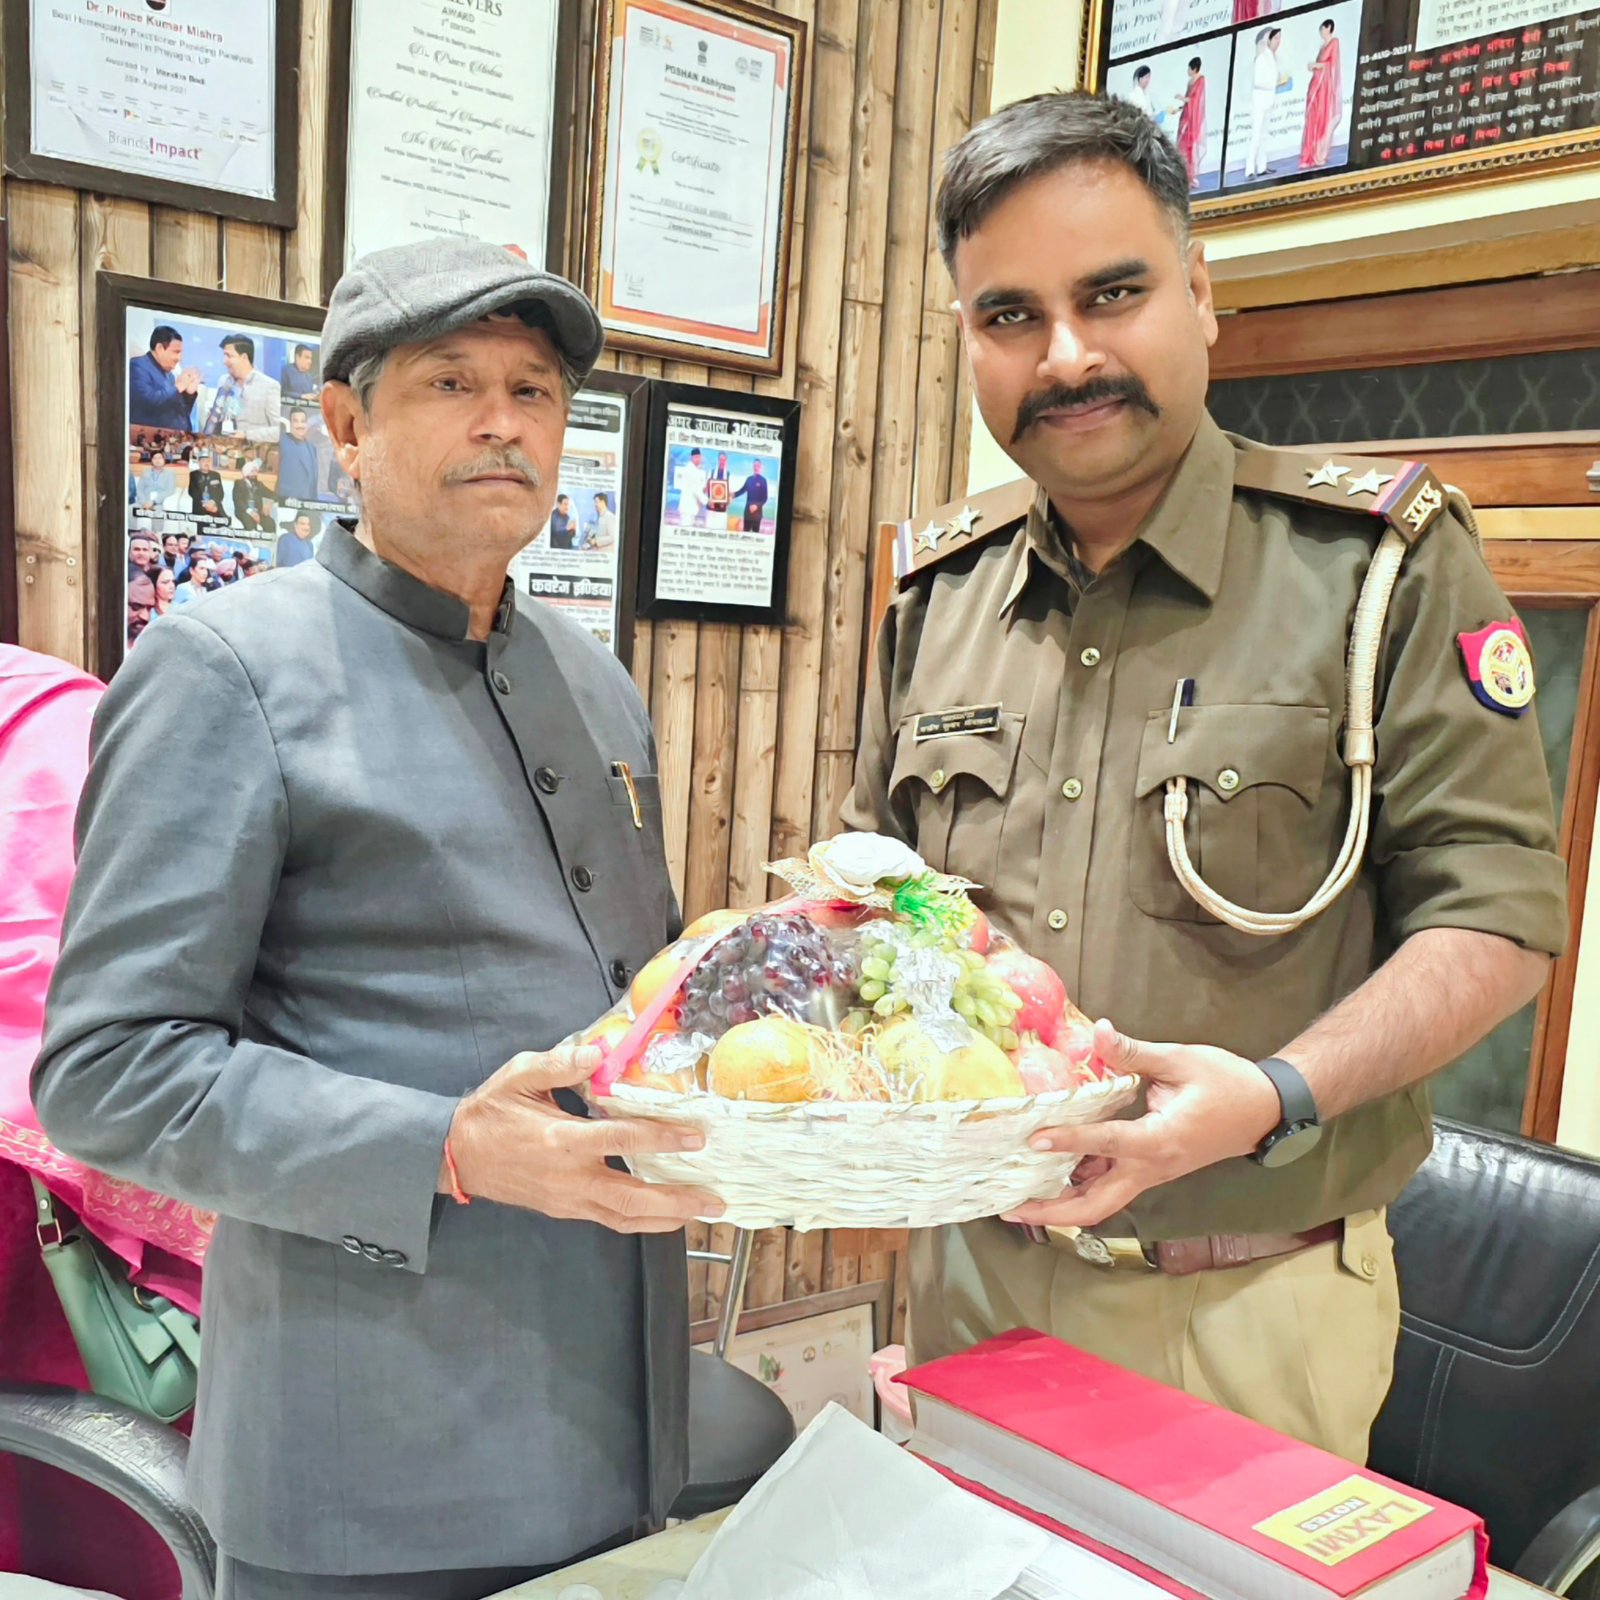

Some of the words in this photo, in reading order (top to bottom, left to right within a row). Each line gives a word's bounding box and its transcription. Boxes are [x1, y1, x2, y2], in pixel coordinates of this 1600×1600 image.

[106, 4, 143, 23] Prince
[147, 14, 183, 33] Kumar
[186, 24, 223, 43] Mishra
[441, 6, 475, 23] AWARD
[1520, 46, 1548, 62] 2021
[665, 63, 699, 82] POSHAN
[1538, 75, 1583, 92] सम्मानित
[671, 150, 721, 173] Certificate
[1301, 1498, 1365, 1531] NOTES
[1304, 1500, 1418, 1558] LAXMI
